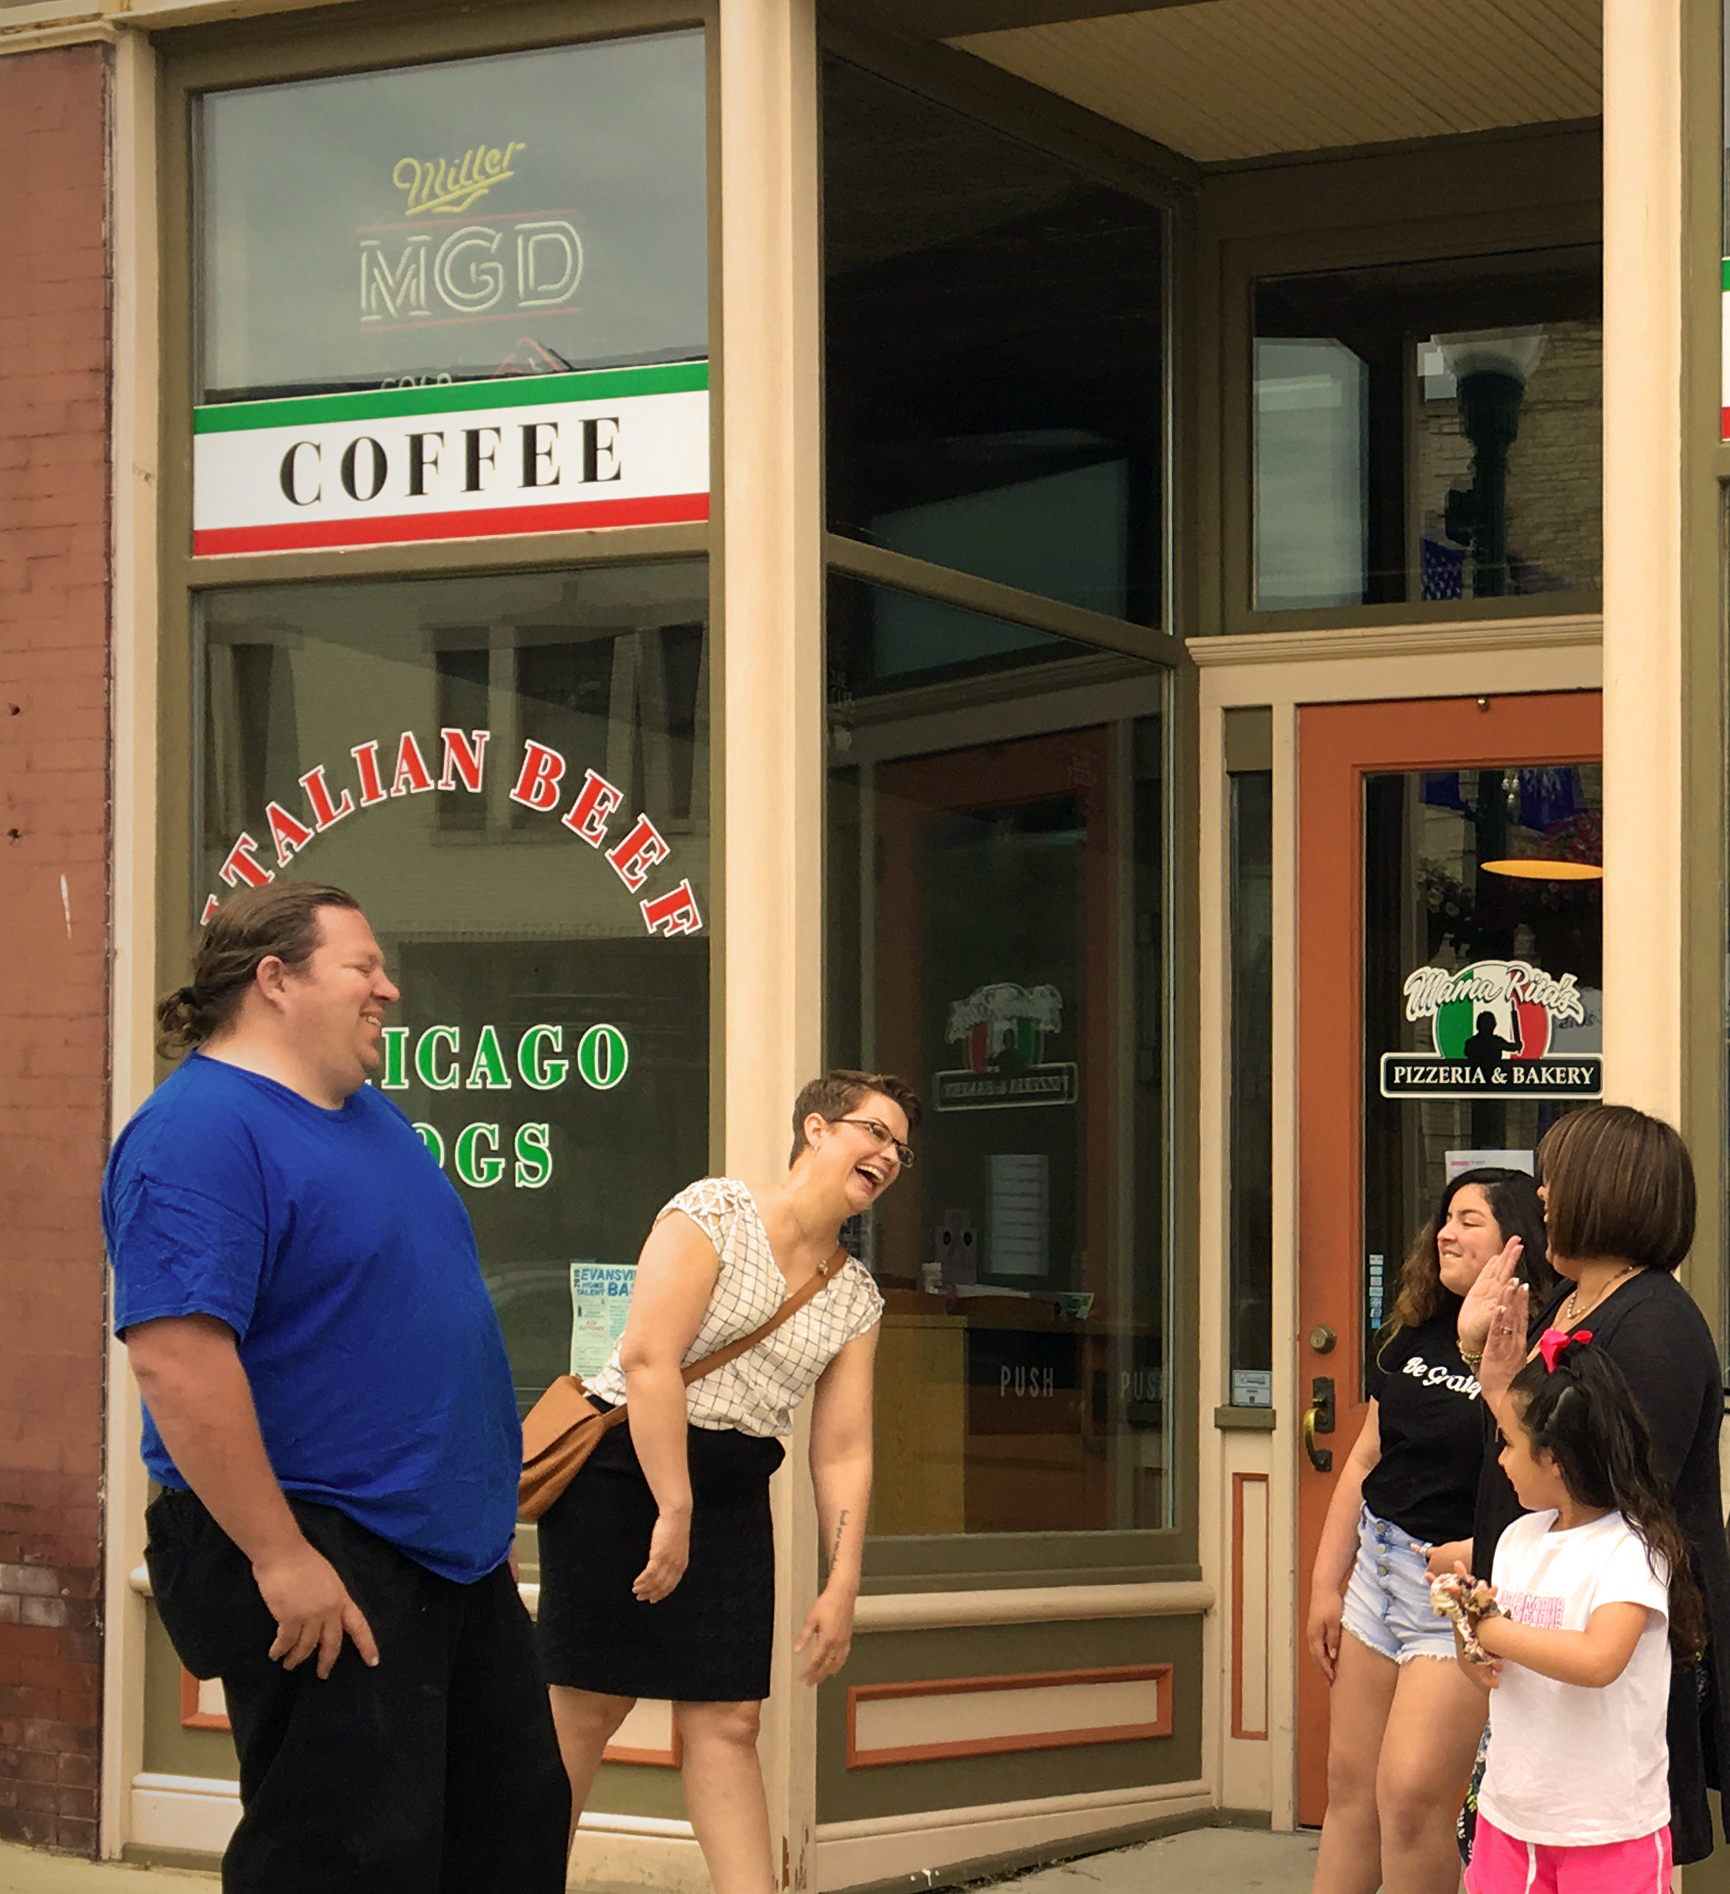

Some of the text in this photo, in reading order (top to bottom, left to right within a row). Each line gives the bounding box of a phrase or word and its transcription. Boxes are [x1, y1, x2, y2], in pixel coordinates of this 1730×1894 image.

[392, 141, 524, 210] Miller
[360, 220, 583, 321] MGD
[279, 416, 623, 507] COFFEE
[509, 738, 703, 939] BEEF
[1405, 966, 1582, 1023] Mama Rita's
[366, 1024, 629, 1091] ICAGO
[1393, 1066, 1595, 1085] PIZZERIA & BAKERY
[412, 1122, 552, 1188] GS
[1000, 1365, 1054, 1397] PUSH
[1119, 1370, 1161, 1400] PUS
[1402, 1356, 1428, 1377] Be
